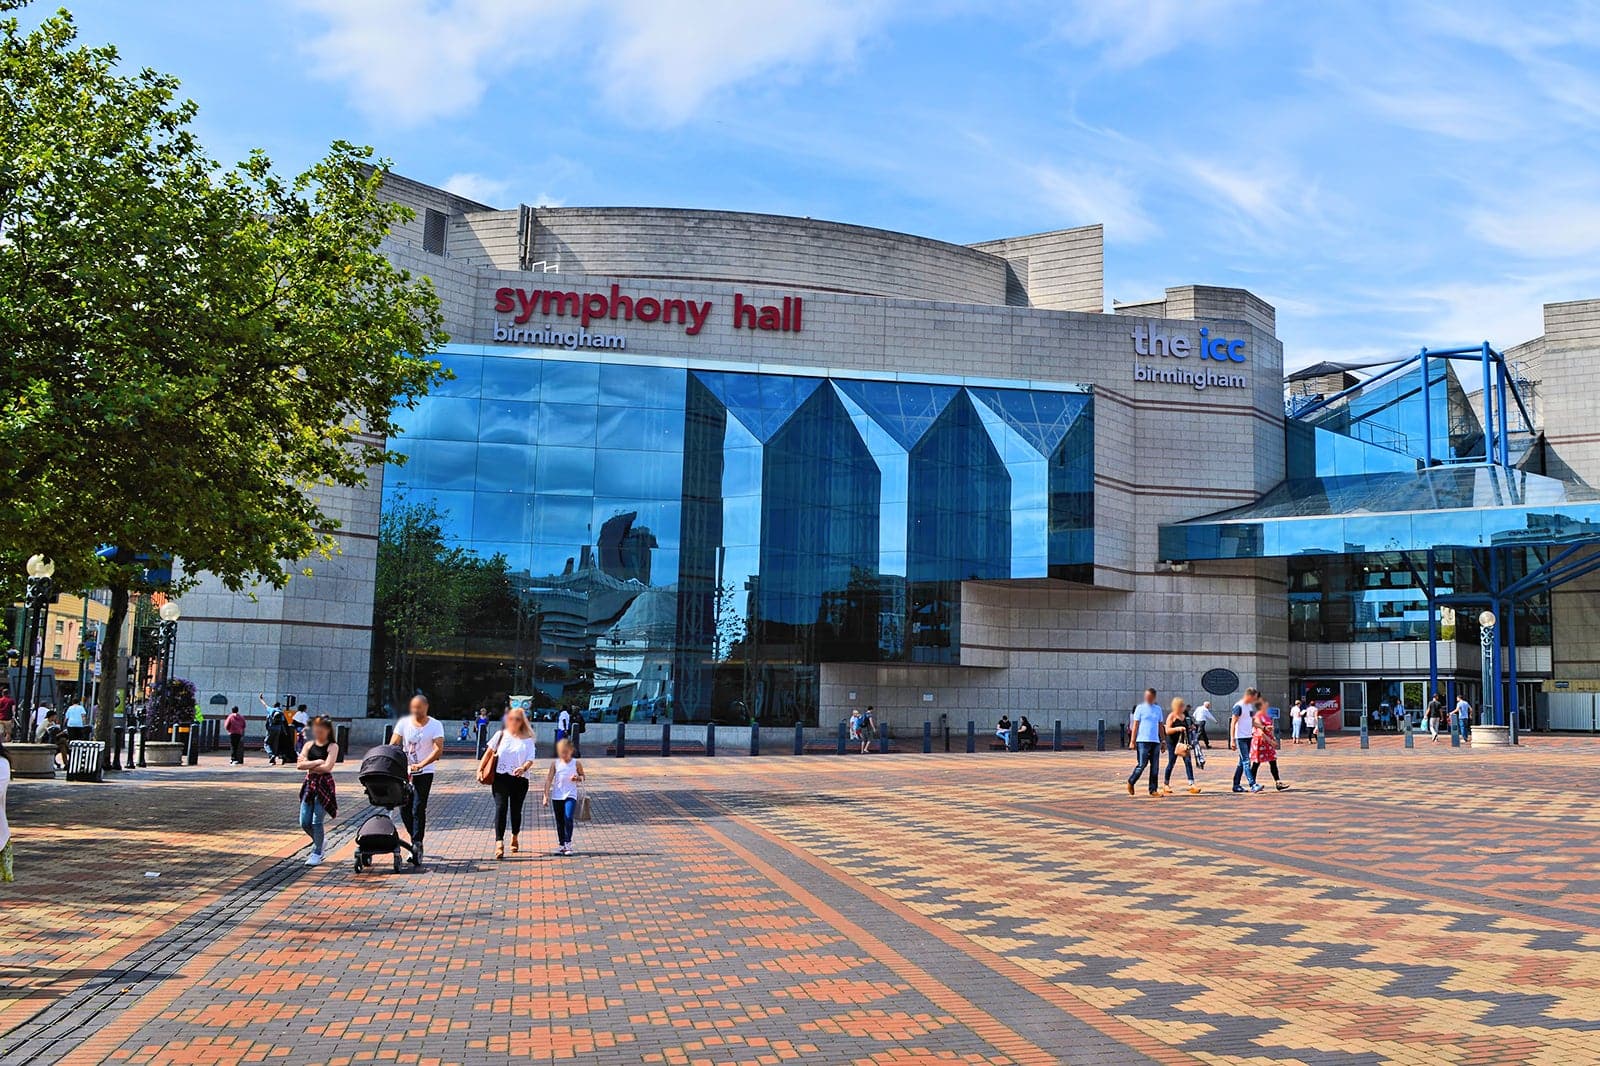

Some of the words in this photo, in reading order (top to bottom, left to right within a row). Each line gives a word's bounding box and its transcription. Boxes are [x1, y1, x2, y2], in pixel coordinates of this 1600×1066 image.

[494, 284, 713, 335] symphony
[734, 293, 803, 332] hall
[492, 319, 627, 350] birmingham
[1131, 322, 1191, 358] the
[1200, 327, 1246, 362] icc
[1134, 362, 1246, 390] birmingham
